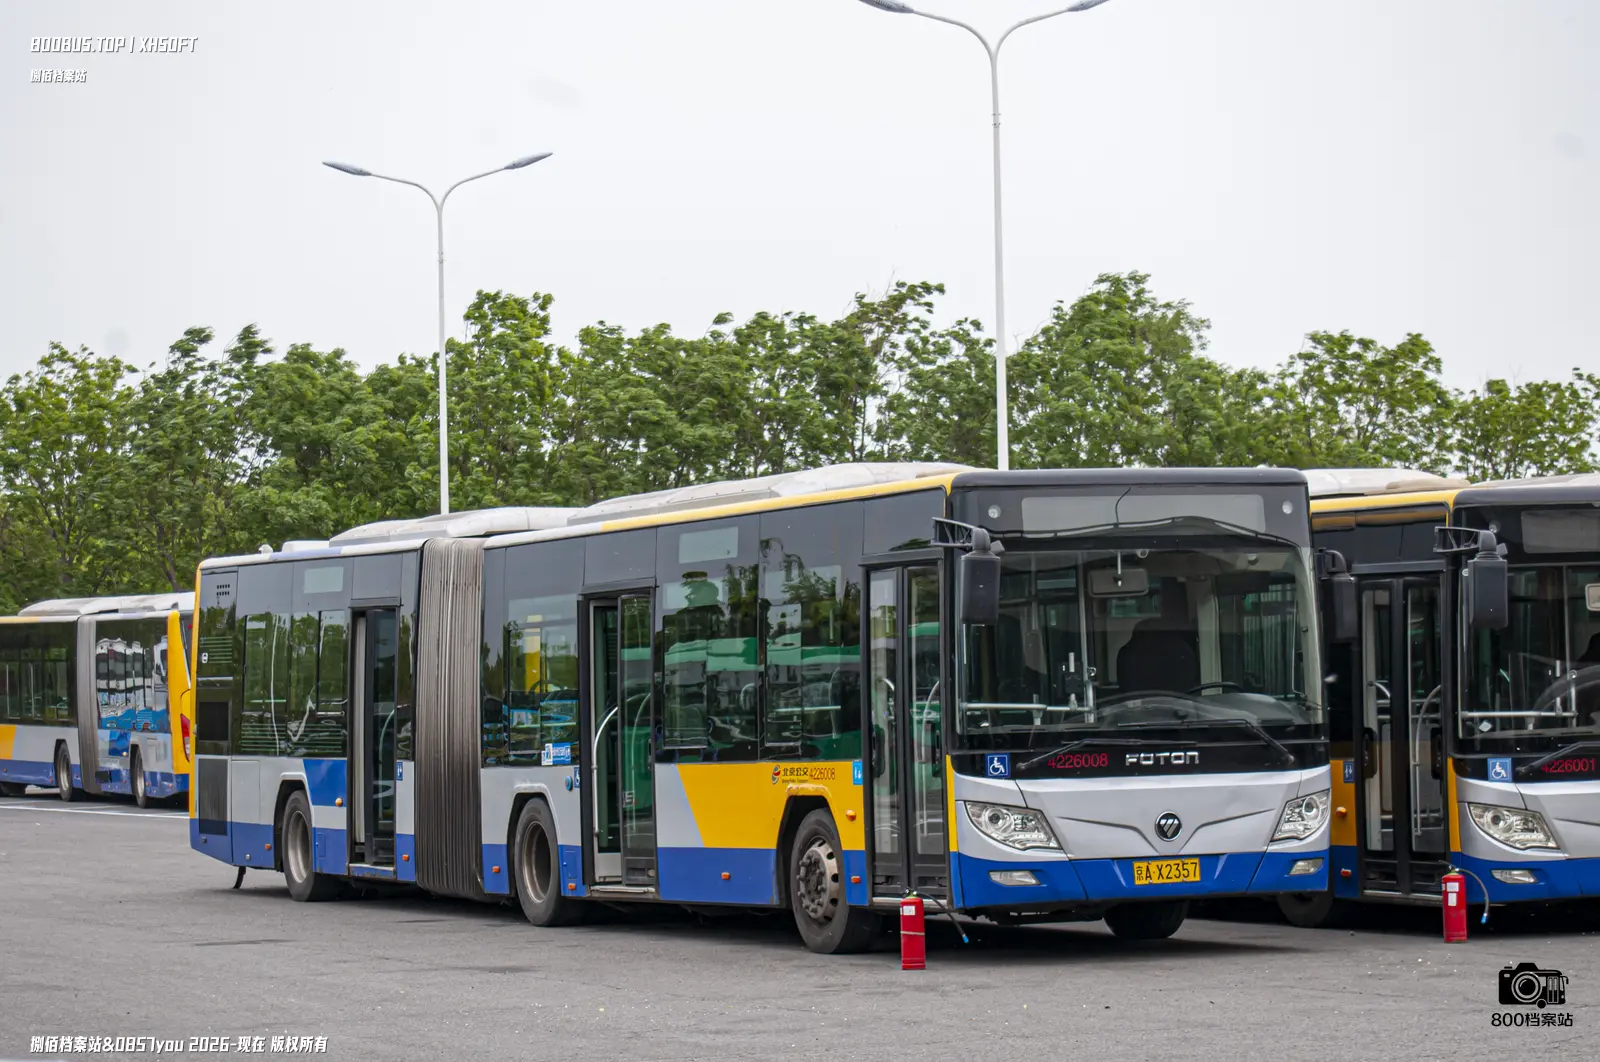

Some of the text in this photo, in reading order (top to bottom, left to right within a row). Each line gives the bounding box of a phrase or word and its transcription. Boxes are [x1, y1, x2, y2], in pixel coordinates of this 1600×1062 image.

[1047, 753, 1108, 769] 4226008
[1125, 751, 1200, 766] FOTON
[1541, 758, 1596, 773] 4226001
[782, 767, 809, 777] 北京公交
